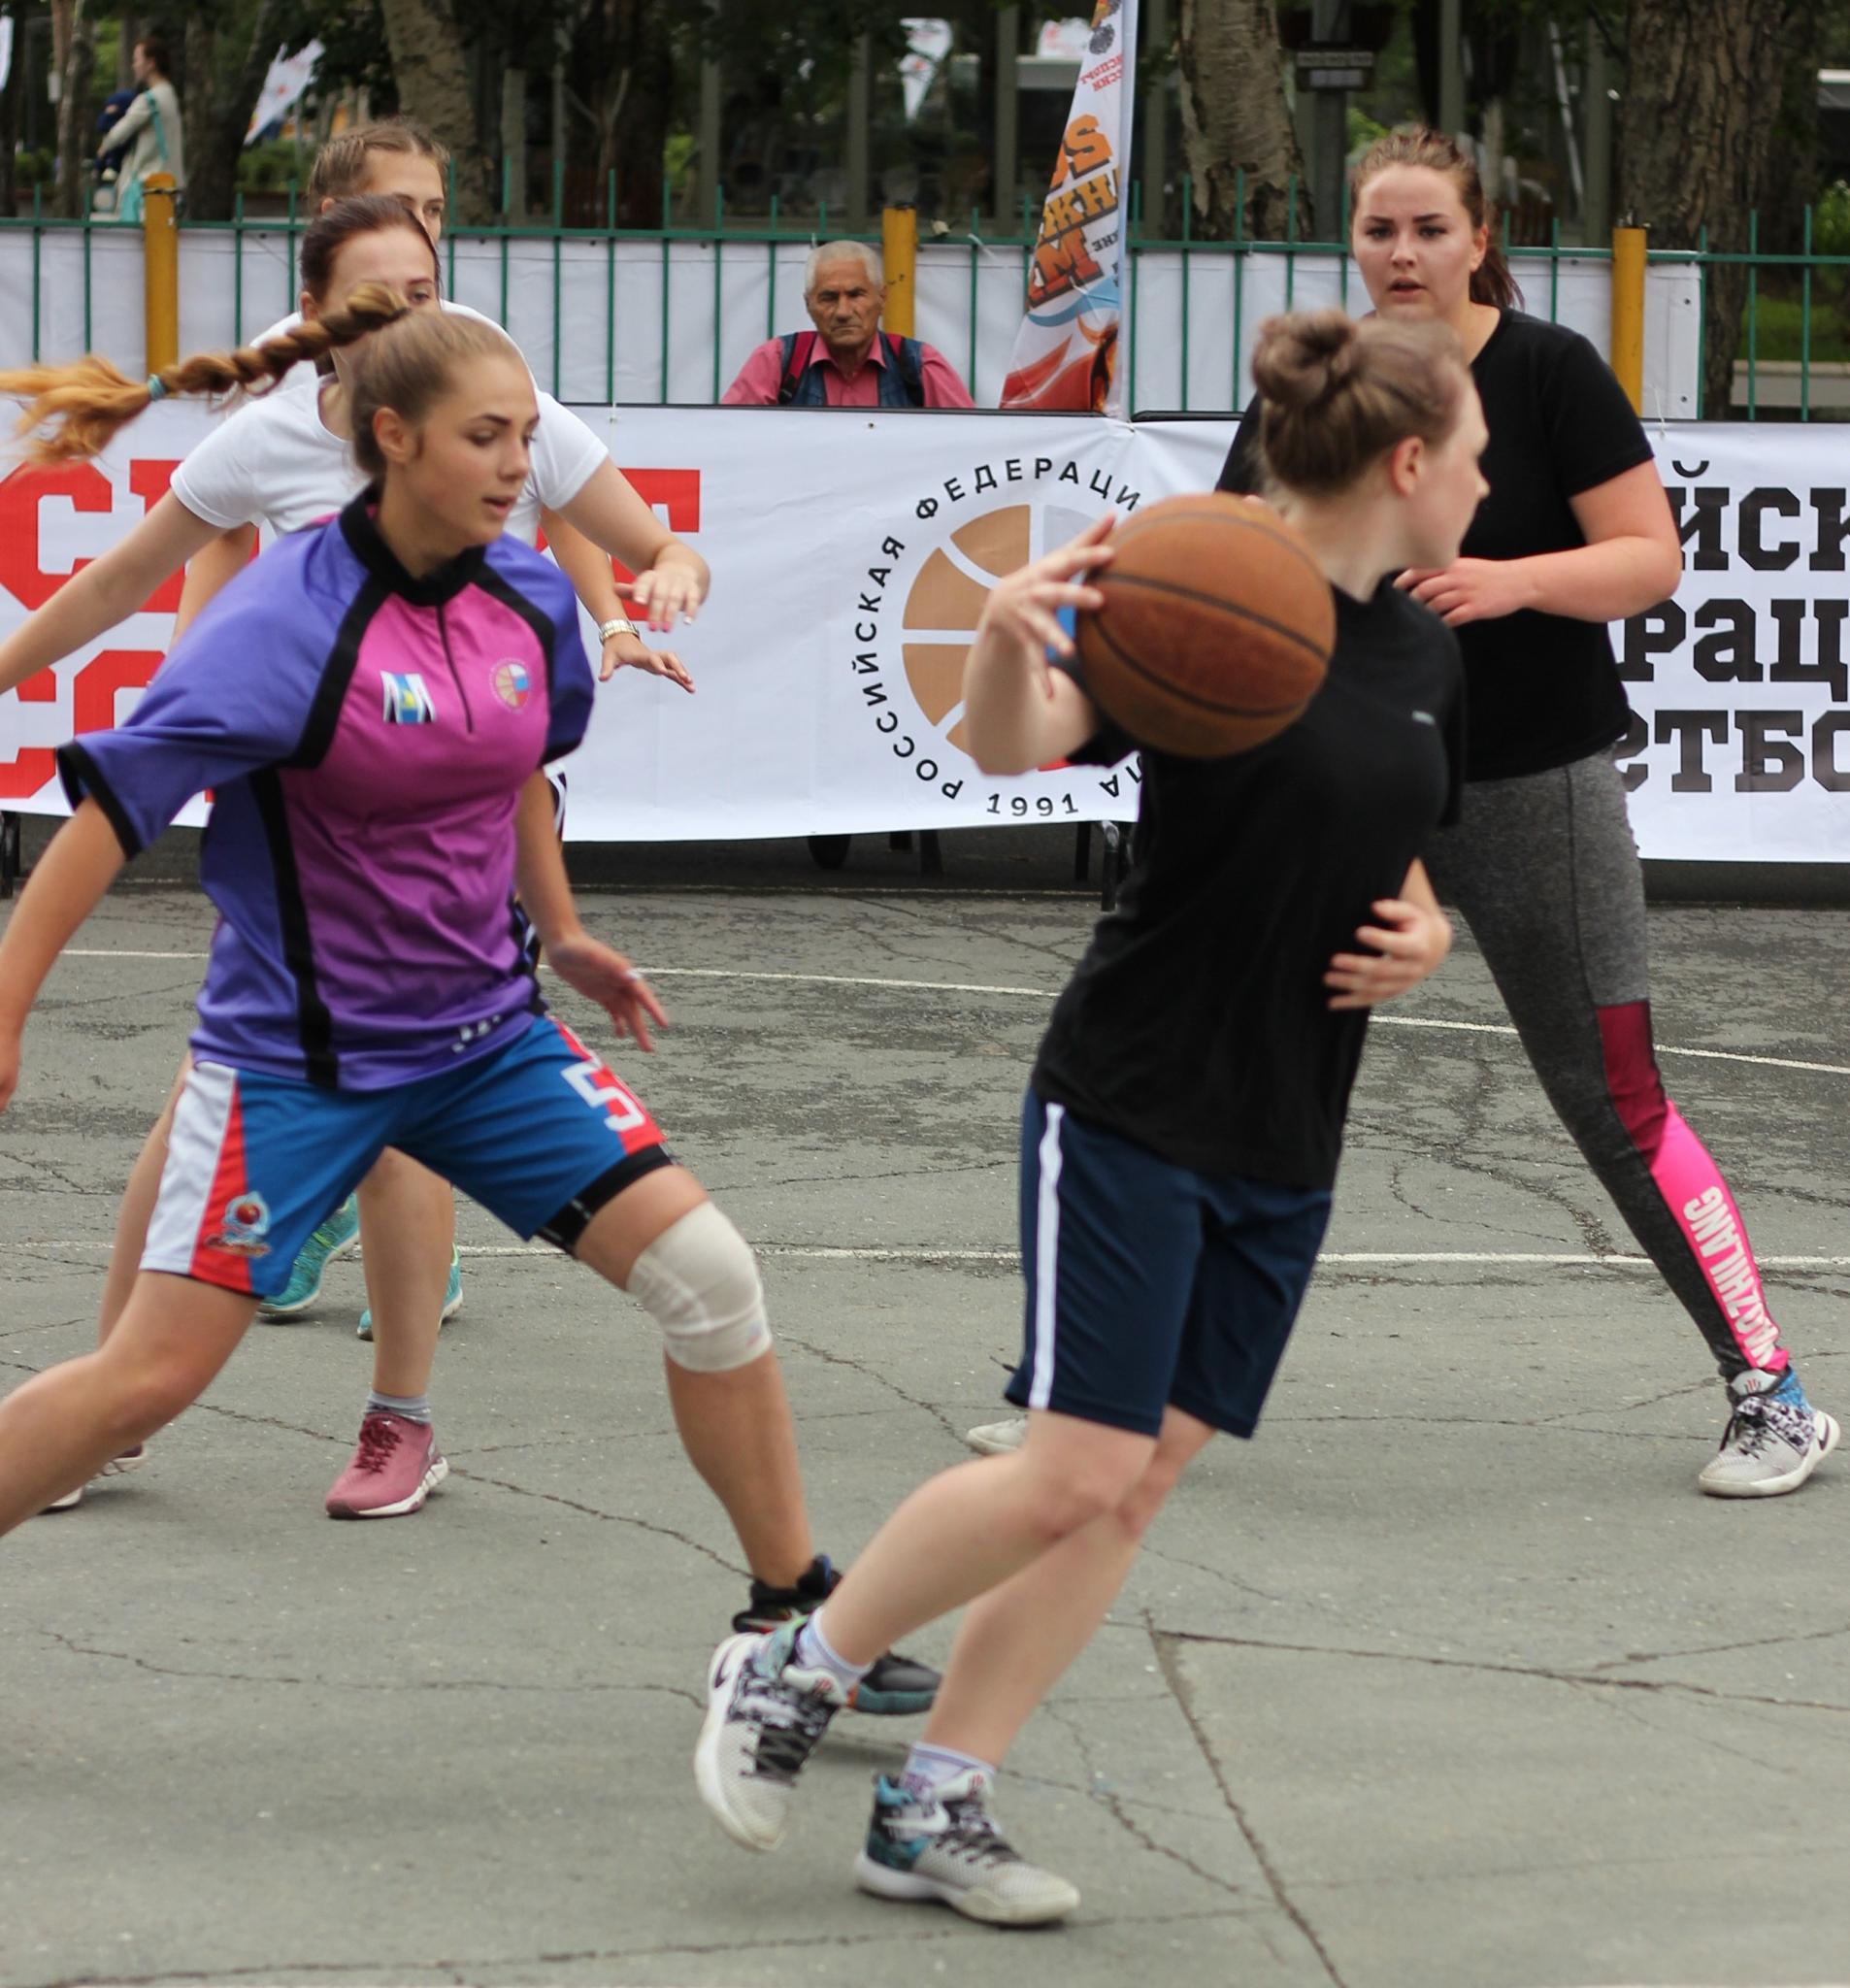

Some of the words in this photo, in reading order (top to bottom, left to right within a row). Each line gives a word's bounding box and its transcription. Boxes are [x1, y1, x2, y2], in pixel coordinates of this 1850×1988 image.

[852, 536, 964, 799] РОССИЙСКАЯ
[986, 793, 1079, 816] 1991
[560, 1051, 646, 1133] 5
